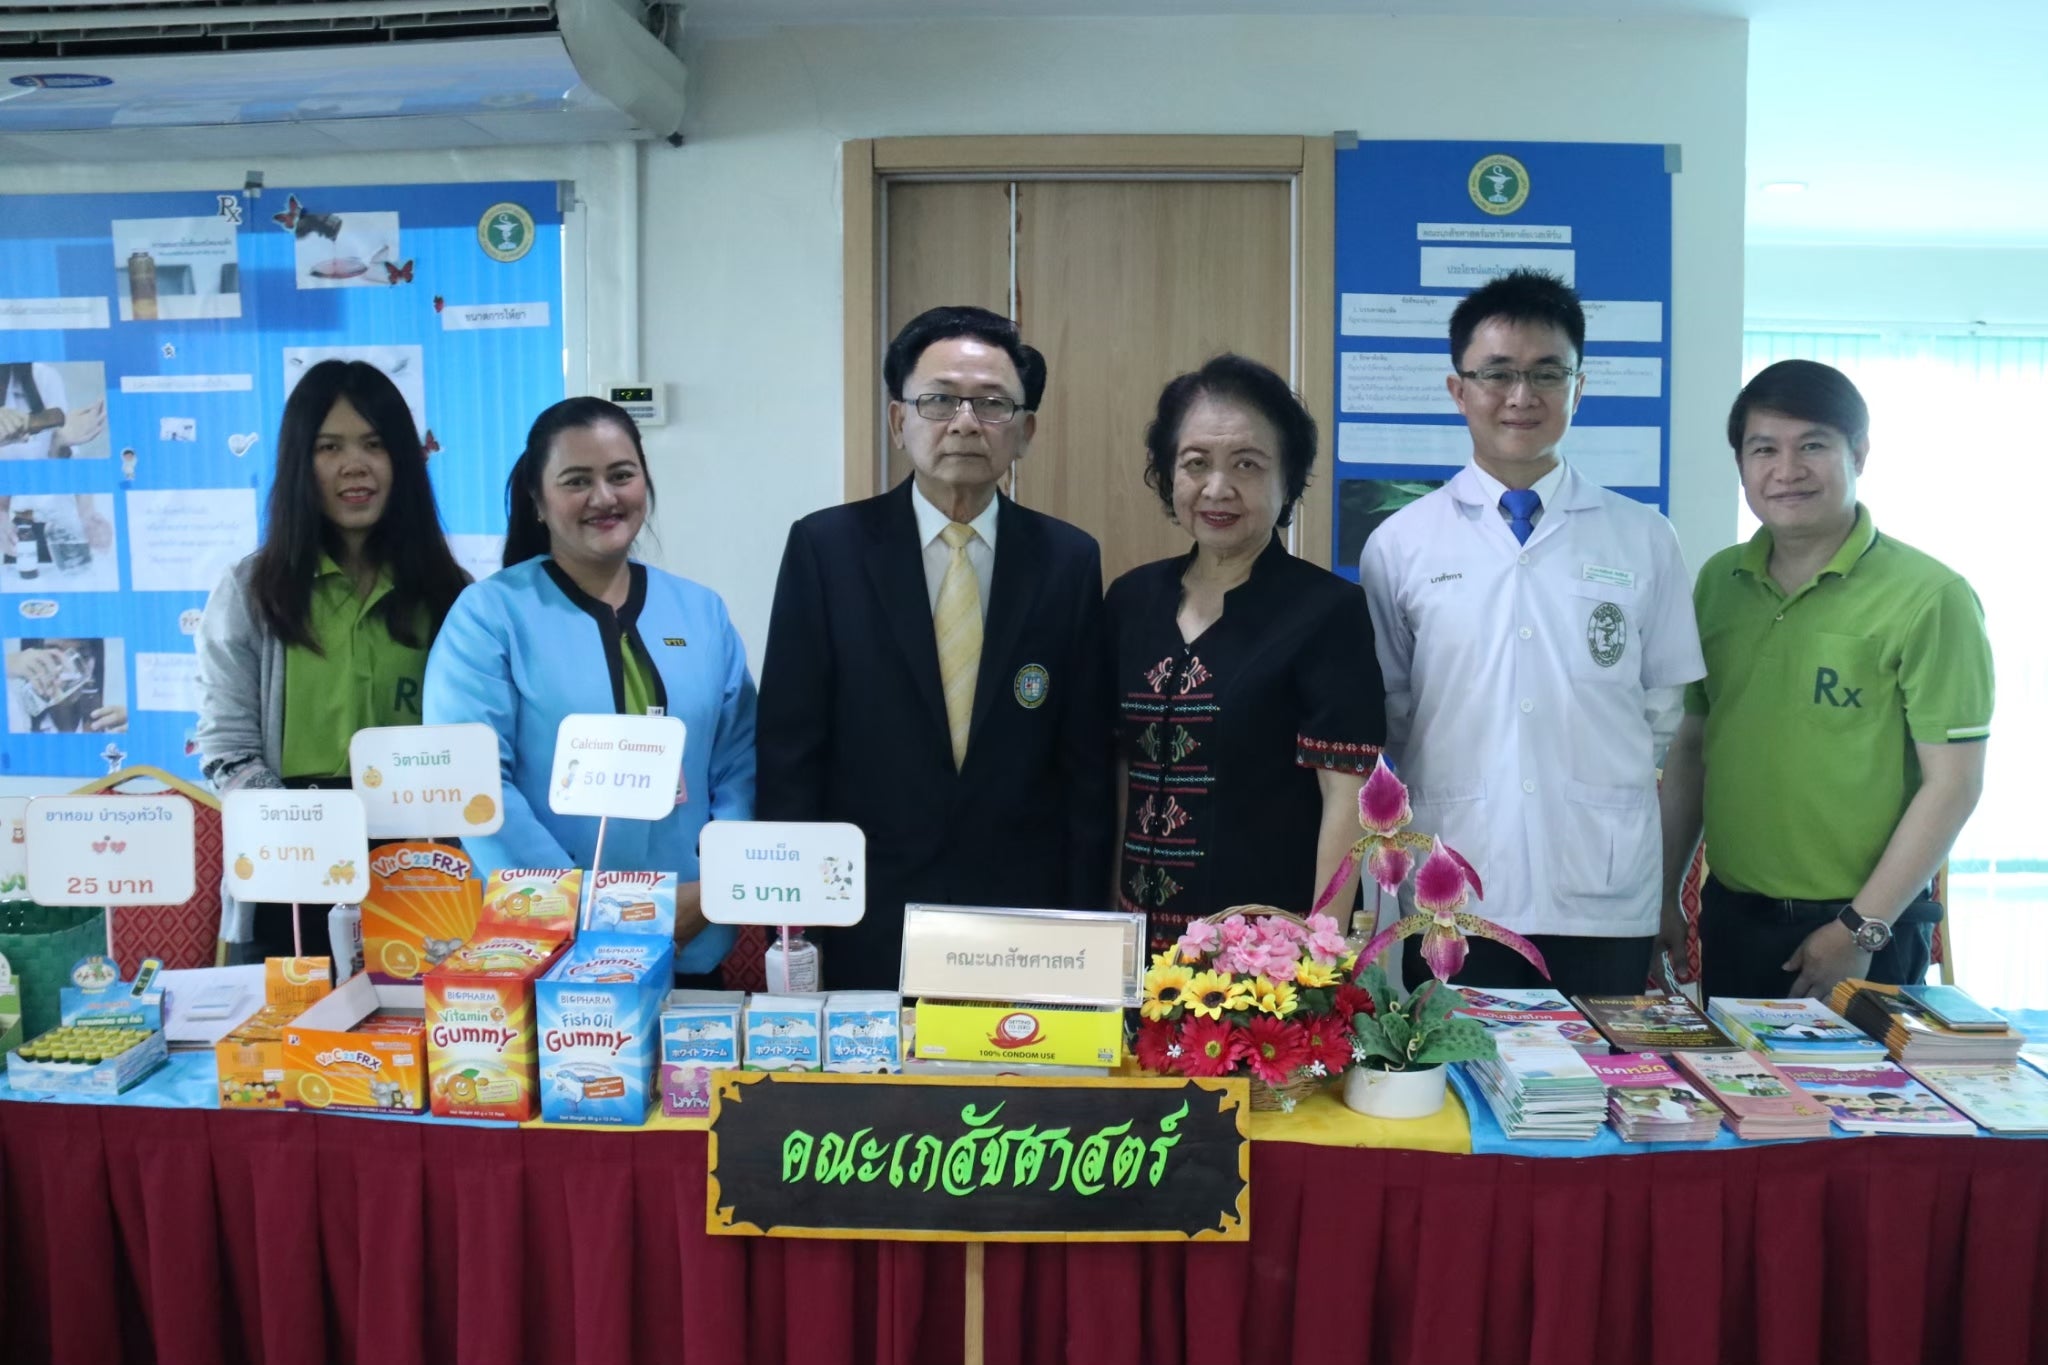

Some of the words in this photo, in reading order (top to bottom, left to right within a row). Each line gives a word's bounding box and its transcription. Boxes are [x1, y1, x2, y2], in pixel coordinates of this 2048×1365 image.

[1814, 667, 1863, 708] Rx
[571, 737, 614, 751] Calcium
[618, 739, 666, 755] Gummy
[392, 750, 451, 768] วิตามินซี
[583, 770, 606, 787] 50
[613, 772, 651, 789] บาท
[392, 790, 413, 805] 10
[423, 788, 463, 804] บาท
[46, 811, 93, 823] ยาหอม
[99, 806, 173, 825] บำรุงหัวใจ
[259, 803, 324, 823] วิตามินซี
[259, 845, 271, 861] 6
[278, 846, 315, 862] บาท
[745, 843, 801, 863] นมเม็ด
[67, 877, 98, 894] 25
[108, 877, 153, 894] บาท
[732, 884, 746, 900] 5
[756, 886, 801, 902] บาท
[946, 946, 1086, 970] คณะเภสัชศาสตร์
[440, 1009, 488, 1022] Vitamin
[561, 1012, 591, 1027] Fish
[593, 1013, 613, 1028] Oil
[980, 1049, 1000, 1057] 100%
[1003, 1051, 1039, 1059] CONDOM
[782, 1099, 1188, 1195] คณะเภสัชศาสตร์
